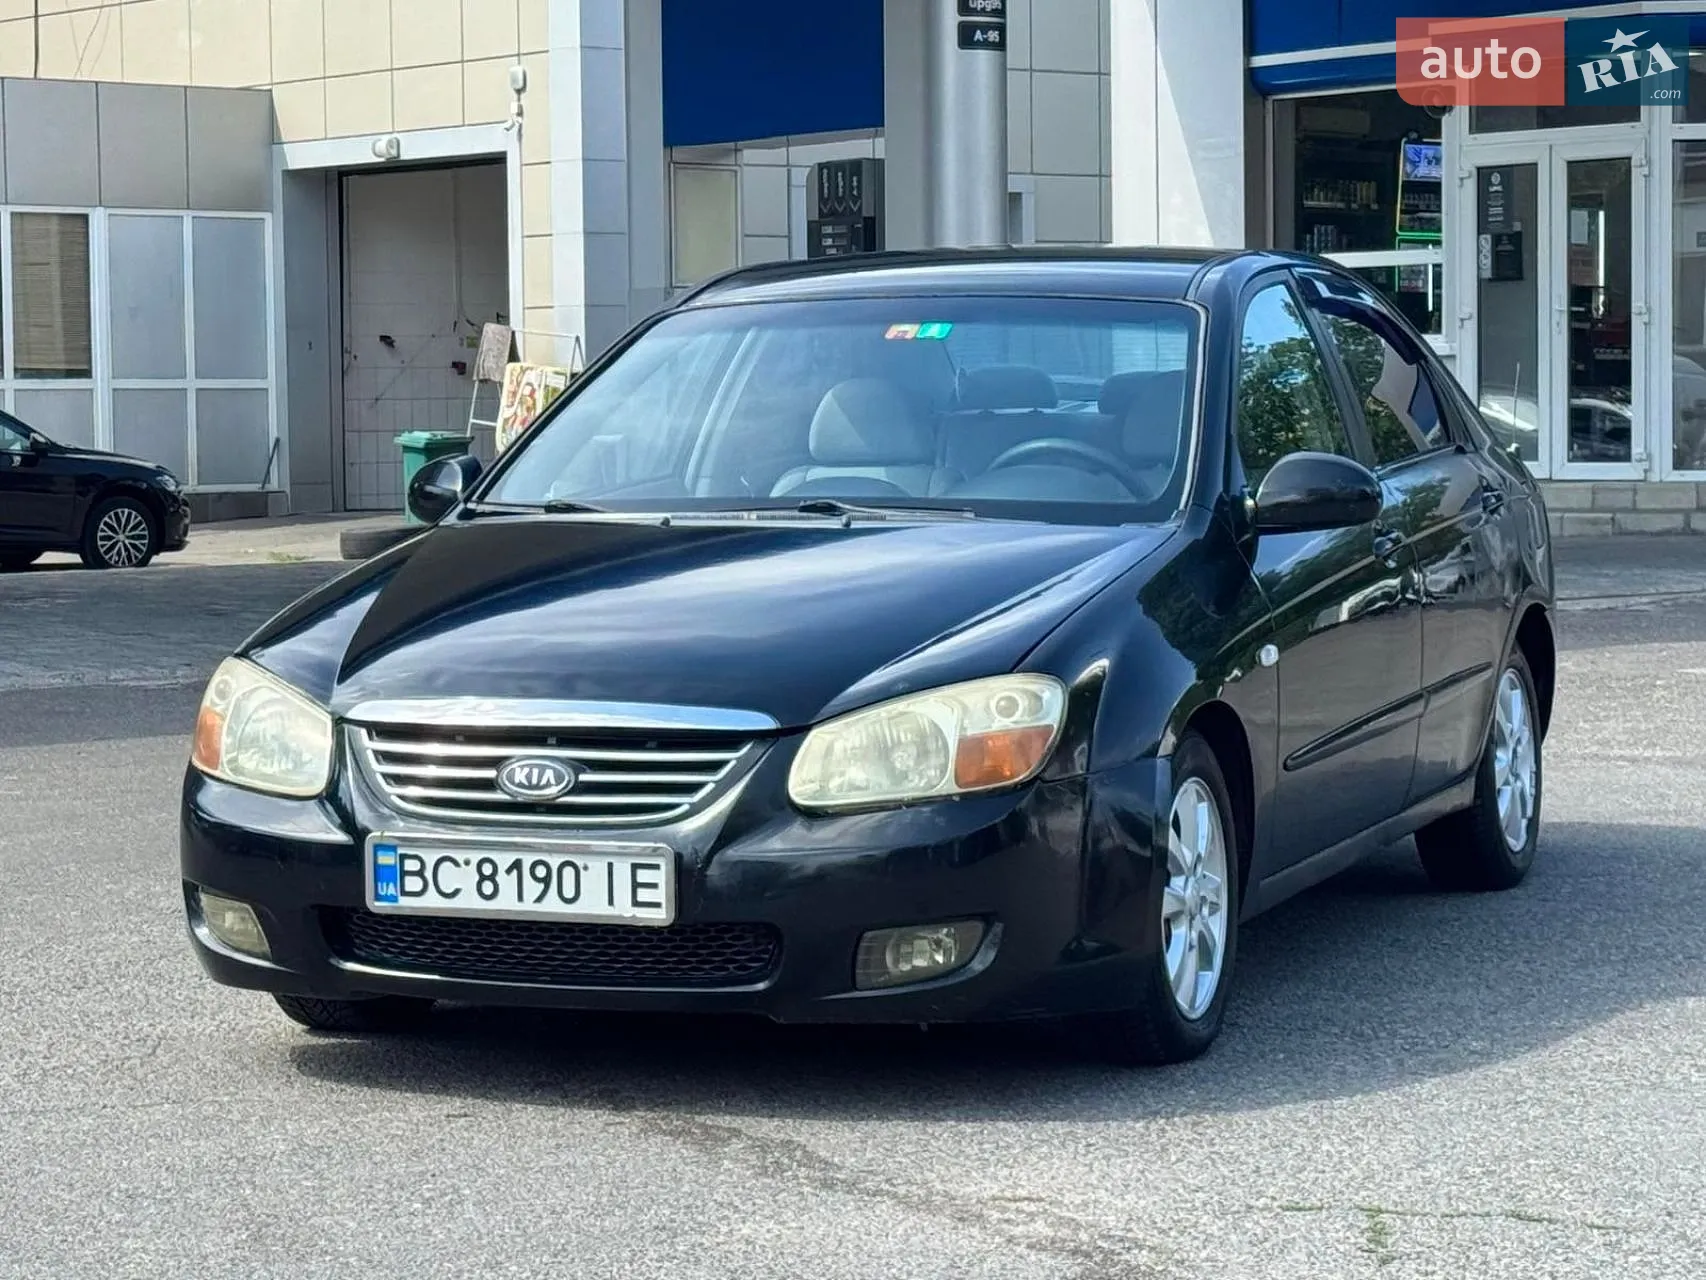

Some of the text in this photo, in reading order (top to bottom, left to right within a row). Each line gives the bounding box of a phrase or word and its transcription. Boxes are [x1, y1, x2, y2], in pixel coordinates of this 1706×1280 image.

[973, 29, 1000, 42] A-95
[513, 767, 557, 787] KIA
[377, 881, 397, 896] UA
[398, 852, 662, 909] BC 8190 IE
